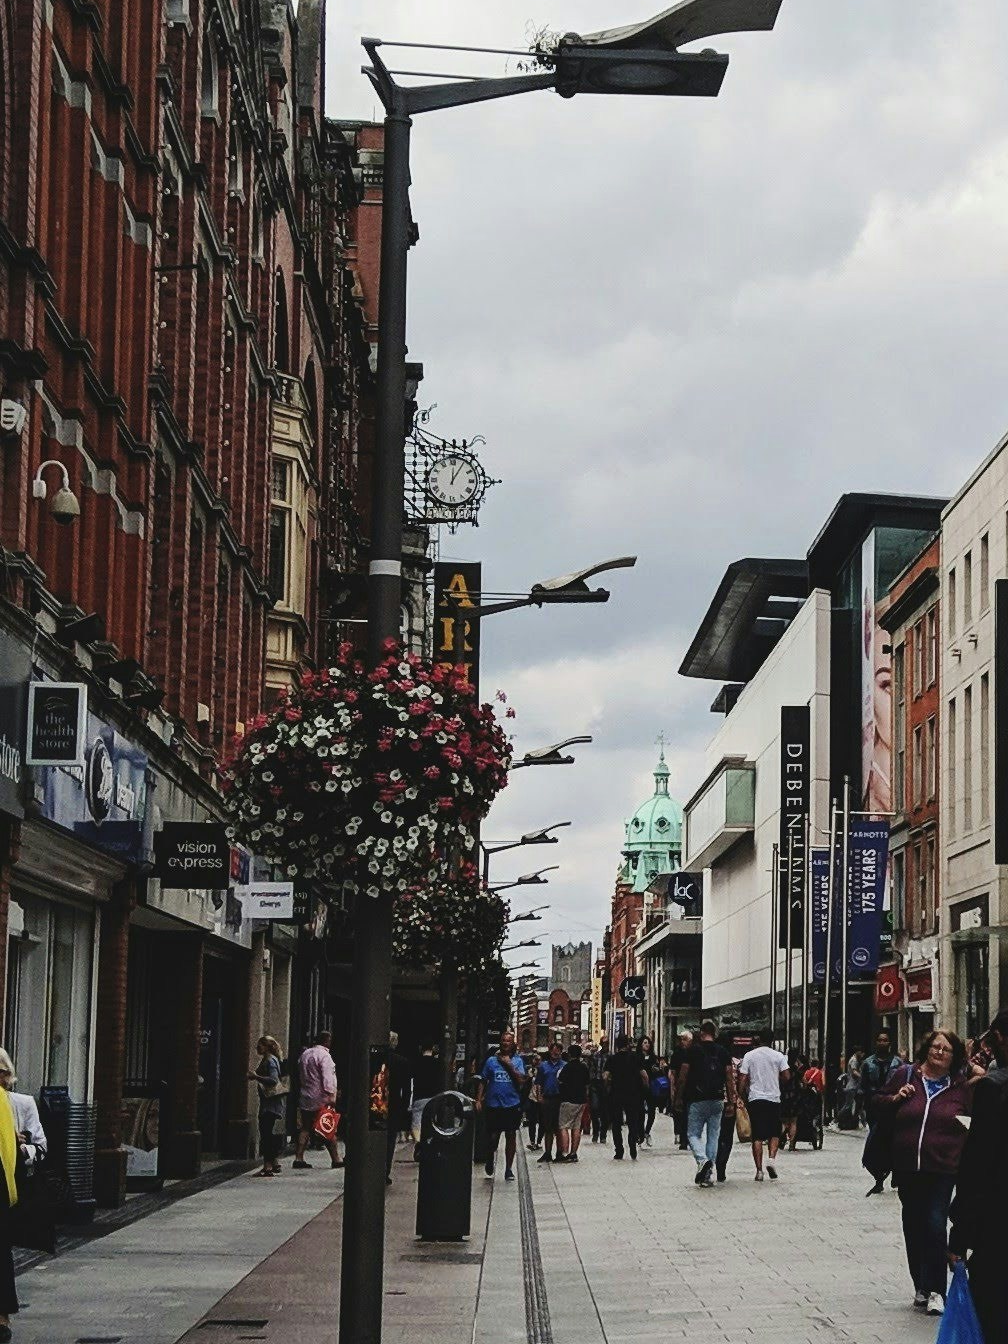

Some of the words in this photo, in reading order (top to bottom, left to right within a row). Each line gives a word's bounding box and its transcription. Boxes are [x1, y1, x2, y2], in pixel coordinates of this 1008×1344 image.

[45, 710, 65, 724] the
[35, 725, 75, 737] health
[39, 738, 71, 749] store
[0, 734, 21, 784] tore
[177, 840, 217, 854] vision
[862, 848, 877, 889] YEARS
[862, 892, 876, 914] 175
